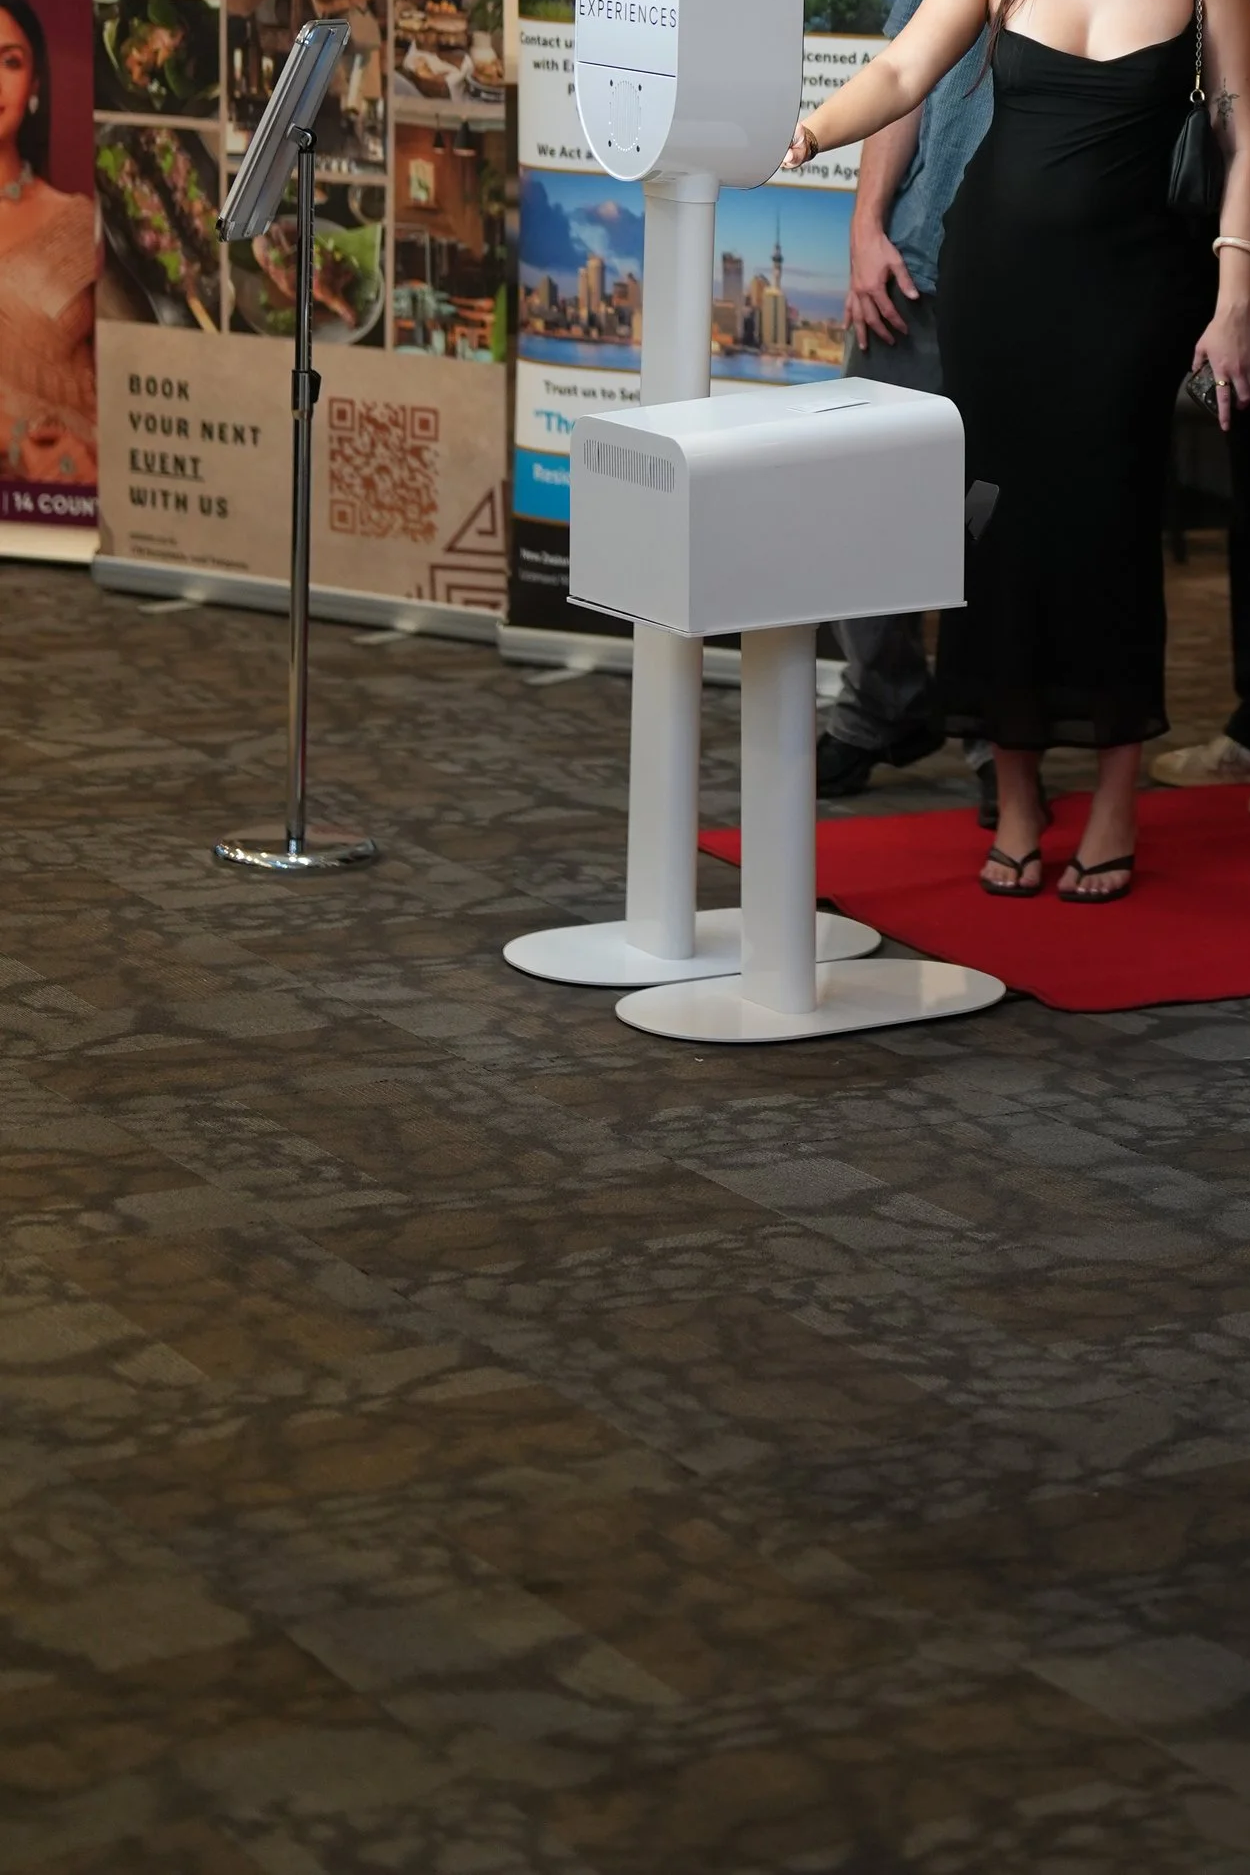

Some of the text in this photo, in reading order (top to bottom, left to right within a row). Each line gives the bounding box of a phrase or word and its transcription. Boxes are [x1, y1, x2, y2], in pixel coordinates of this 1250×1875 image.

[520, 31, 561, 49] Contact
[532, 59, 559, 72] with
[537, 143, 556, 156] We
[560, 145, 581, 159] Act
[129, 374, 190, 402] BOOK
[543, 379, 578, 396] Trust
[582, 386, 597, 399] us
[600, 388, 617, 400] to
[129, 410, 261, 448] YOUR NEXT
[130, 448, 202, 478] EVENT
[129, 485, 229, 519] WITH US
